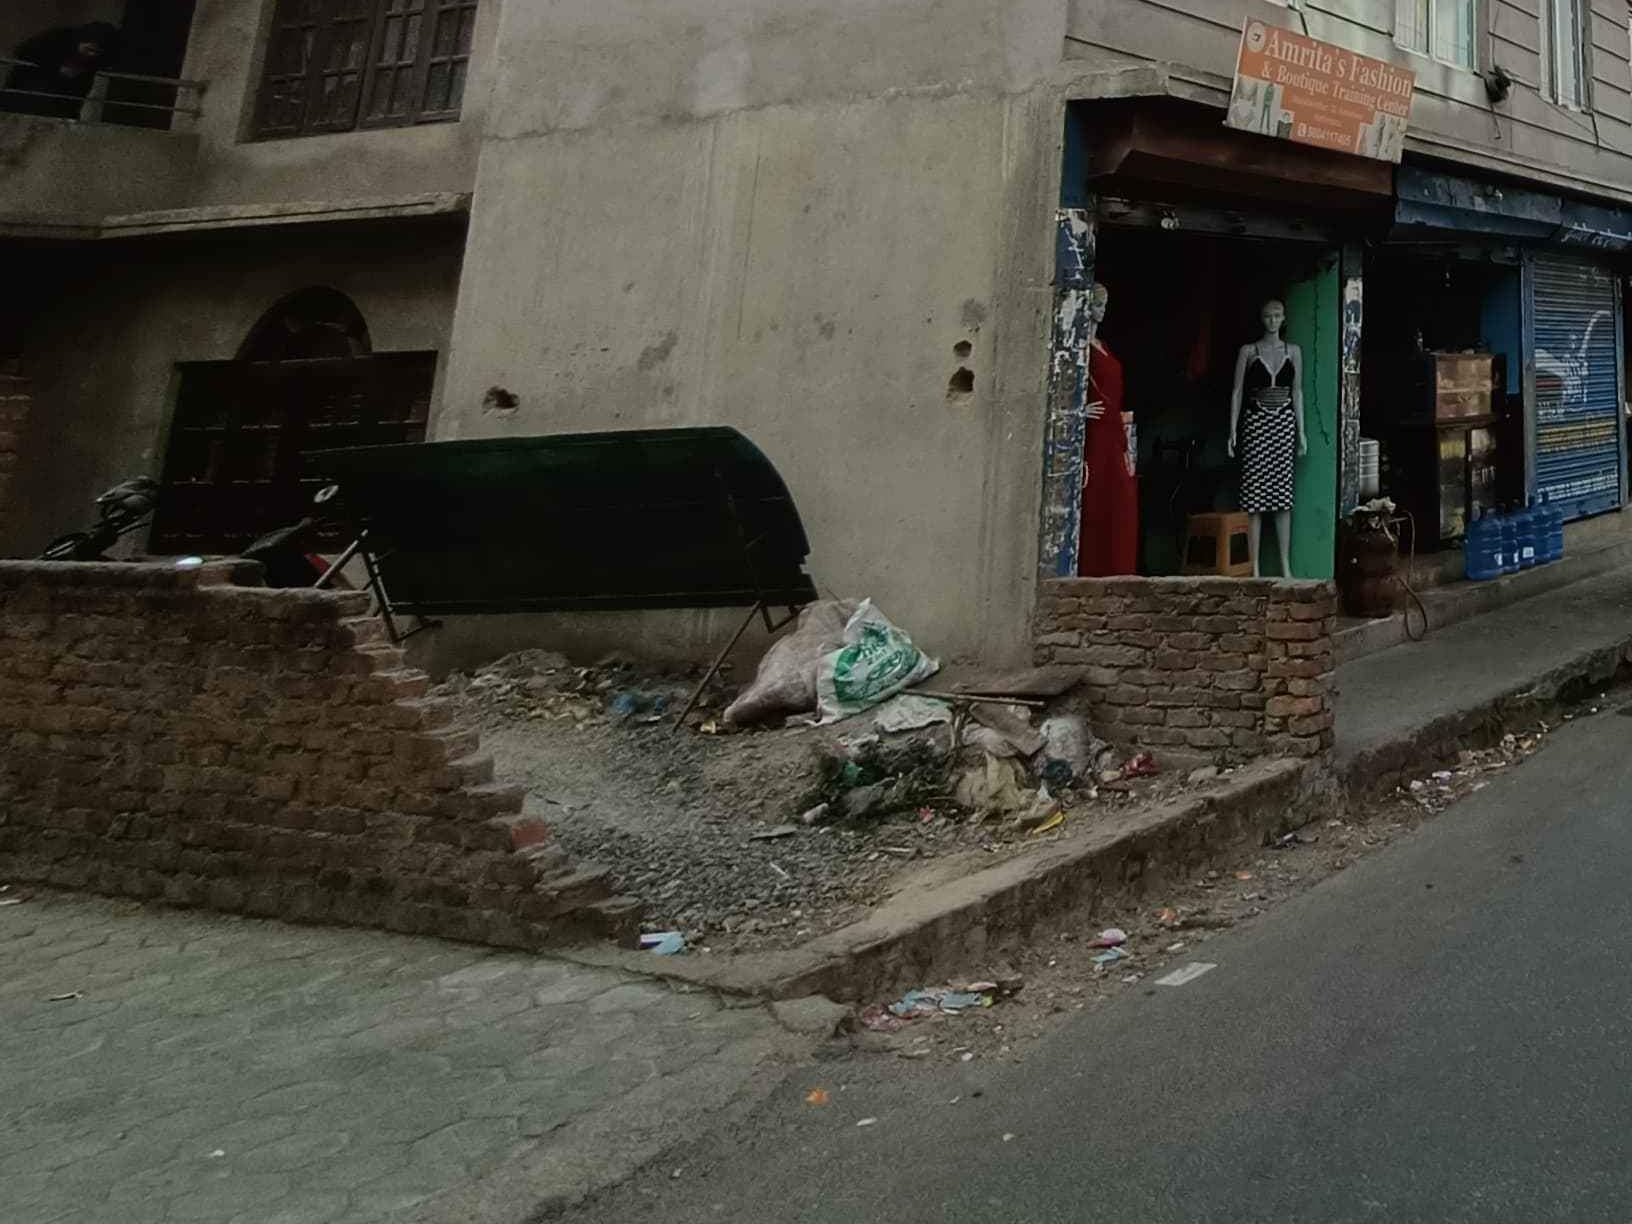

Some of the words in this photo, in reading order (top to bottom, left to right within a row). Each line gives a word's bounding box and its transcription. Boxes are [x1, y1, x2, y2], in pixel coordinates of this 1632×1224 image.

[1262, 61, 1272, 79] &
[1276, 65, 1330, 95] Boutique
[1332, 79, 1376, 110] Training
[1264, 30, 1346, 76] Amrita's
[1350, 56, 1412, 98] Fashion
